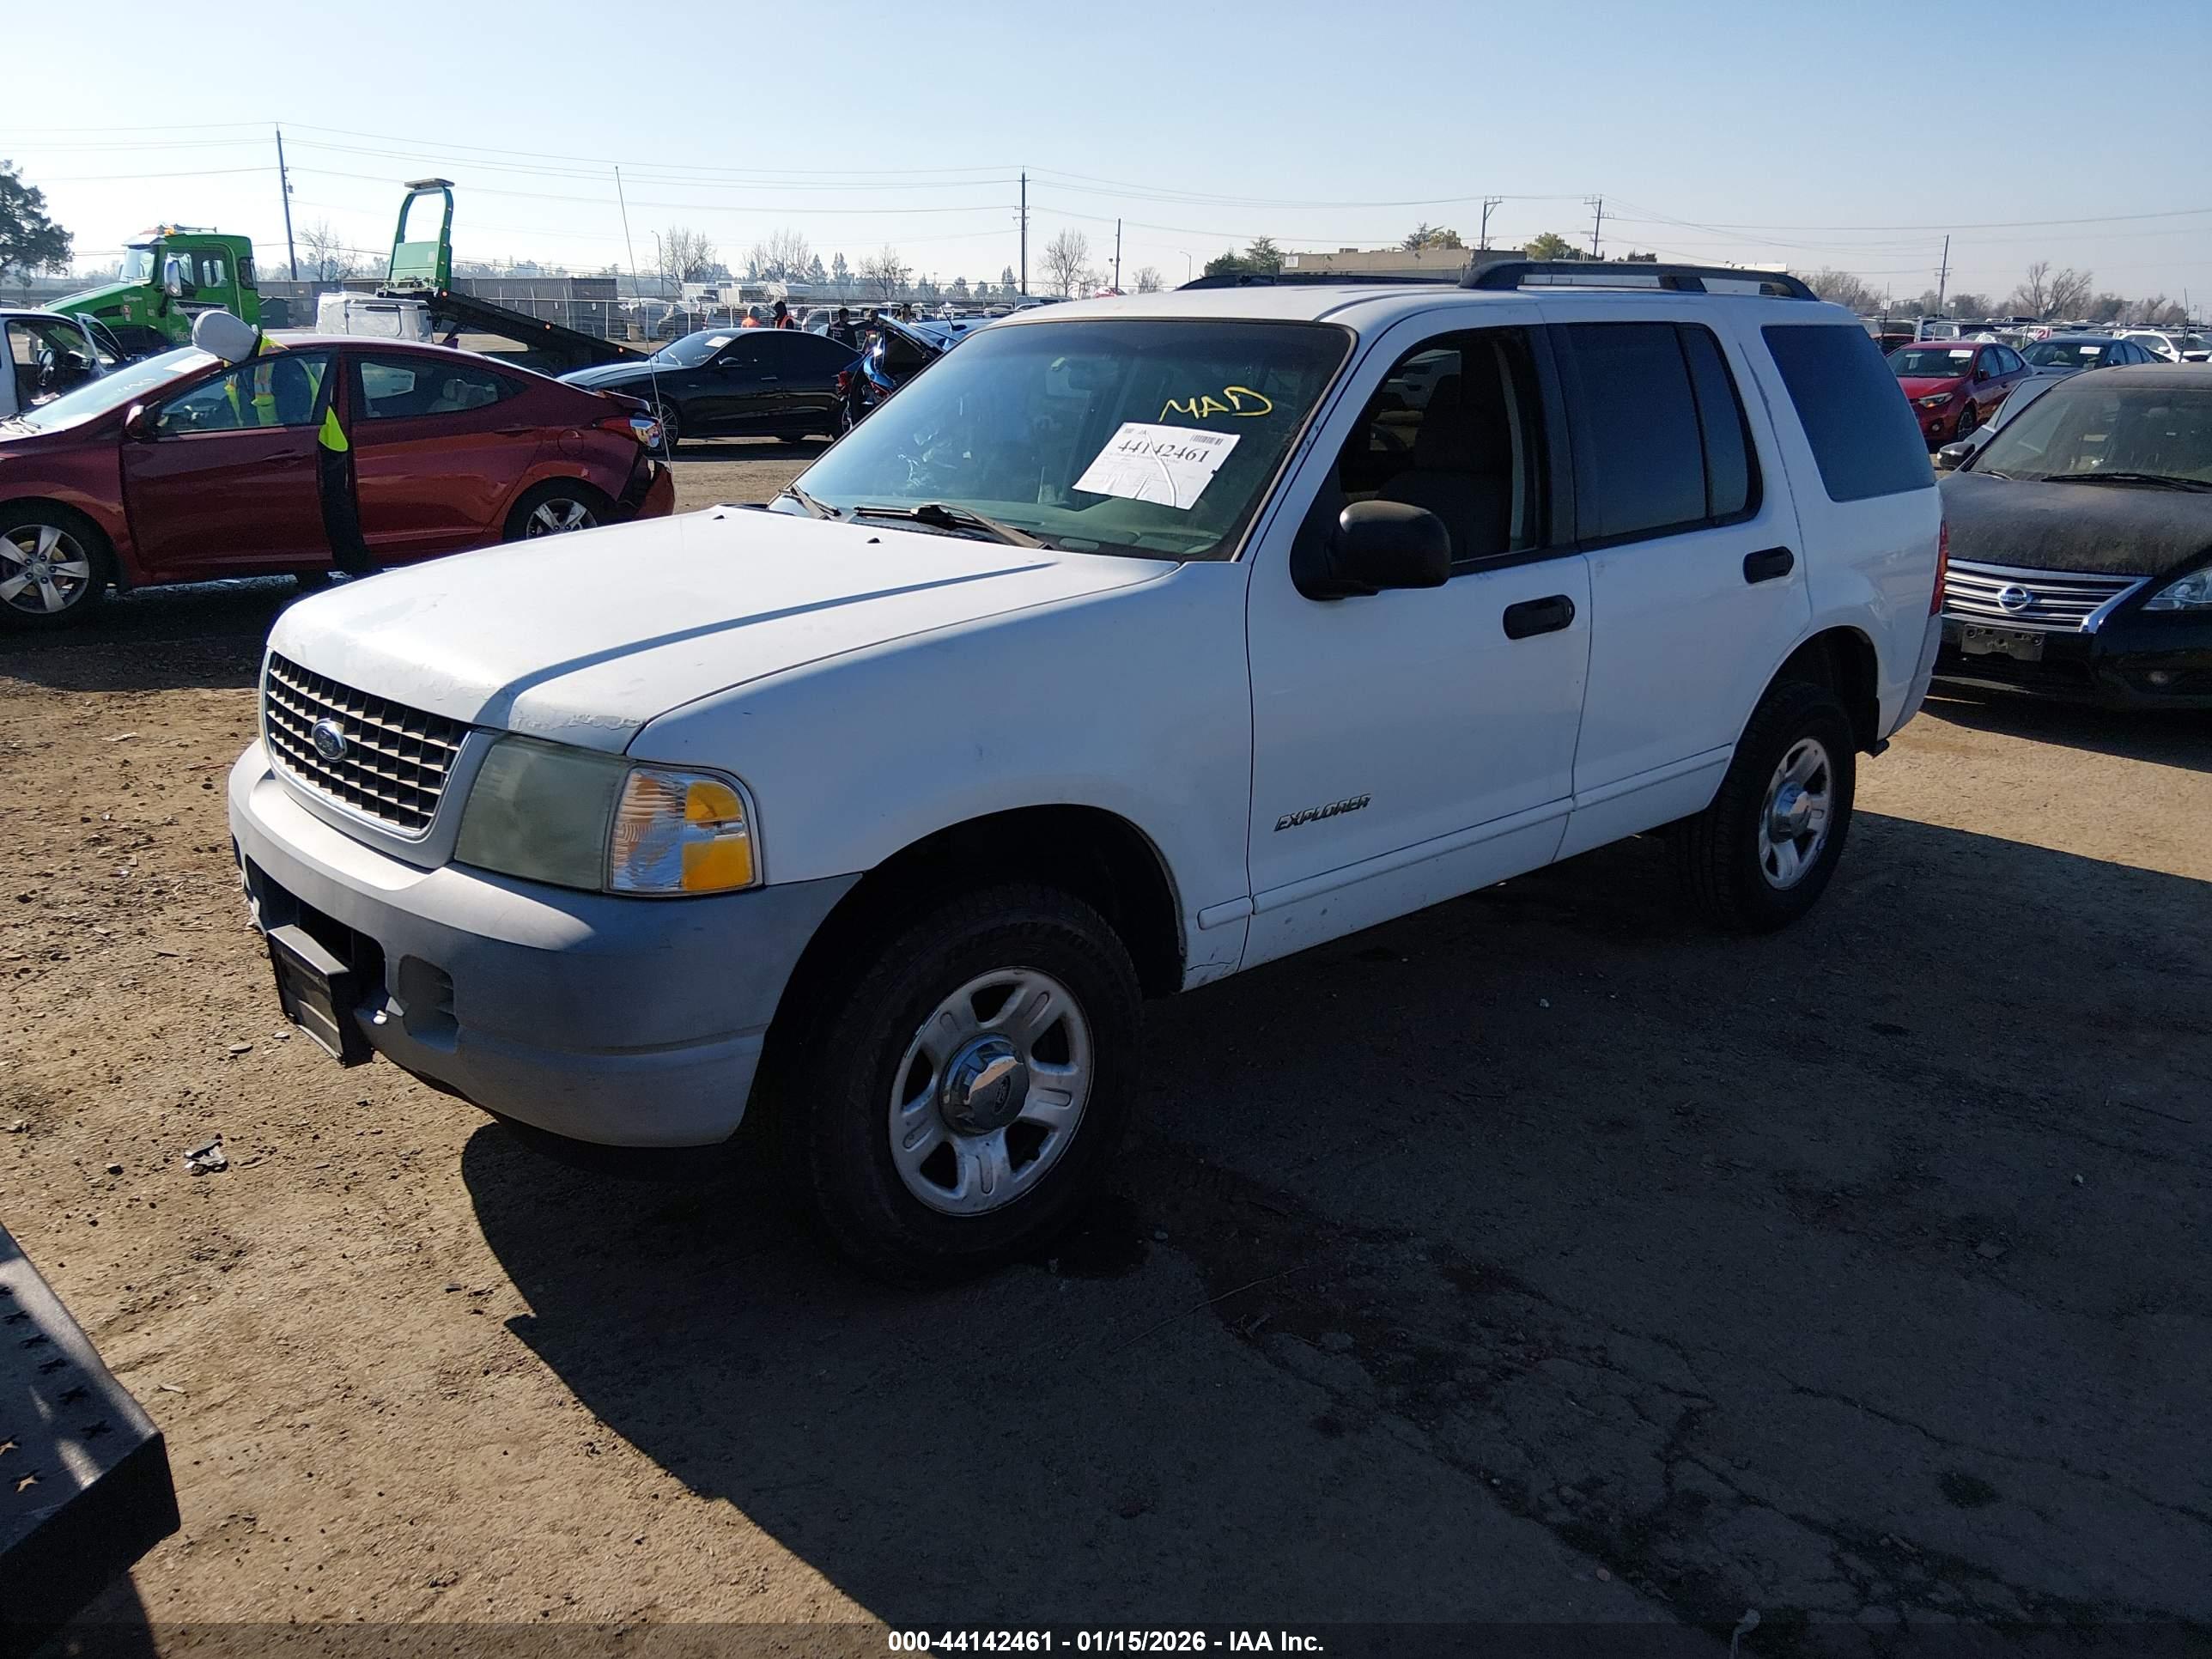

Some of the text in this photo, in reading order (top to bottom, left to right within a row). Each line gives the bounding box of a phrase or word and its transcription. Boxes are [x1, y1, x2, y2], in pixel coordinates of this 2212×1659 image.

[1159, 386, 1273, 422] MAD
[1118, 439, 1210, 464] 44142461
[1273, 793, 1371, 832] EXPLORER
